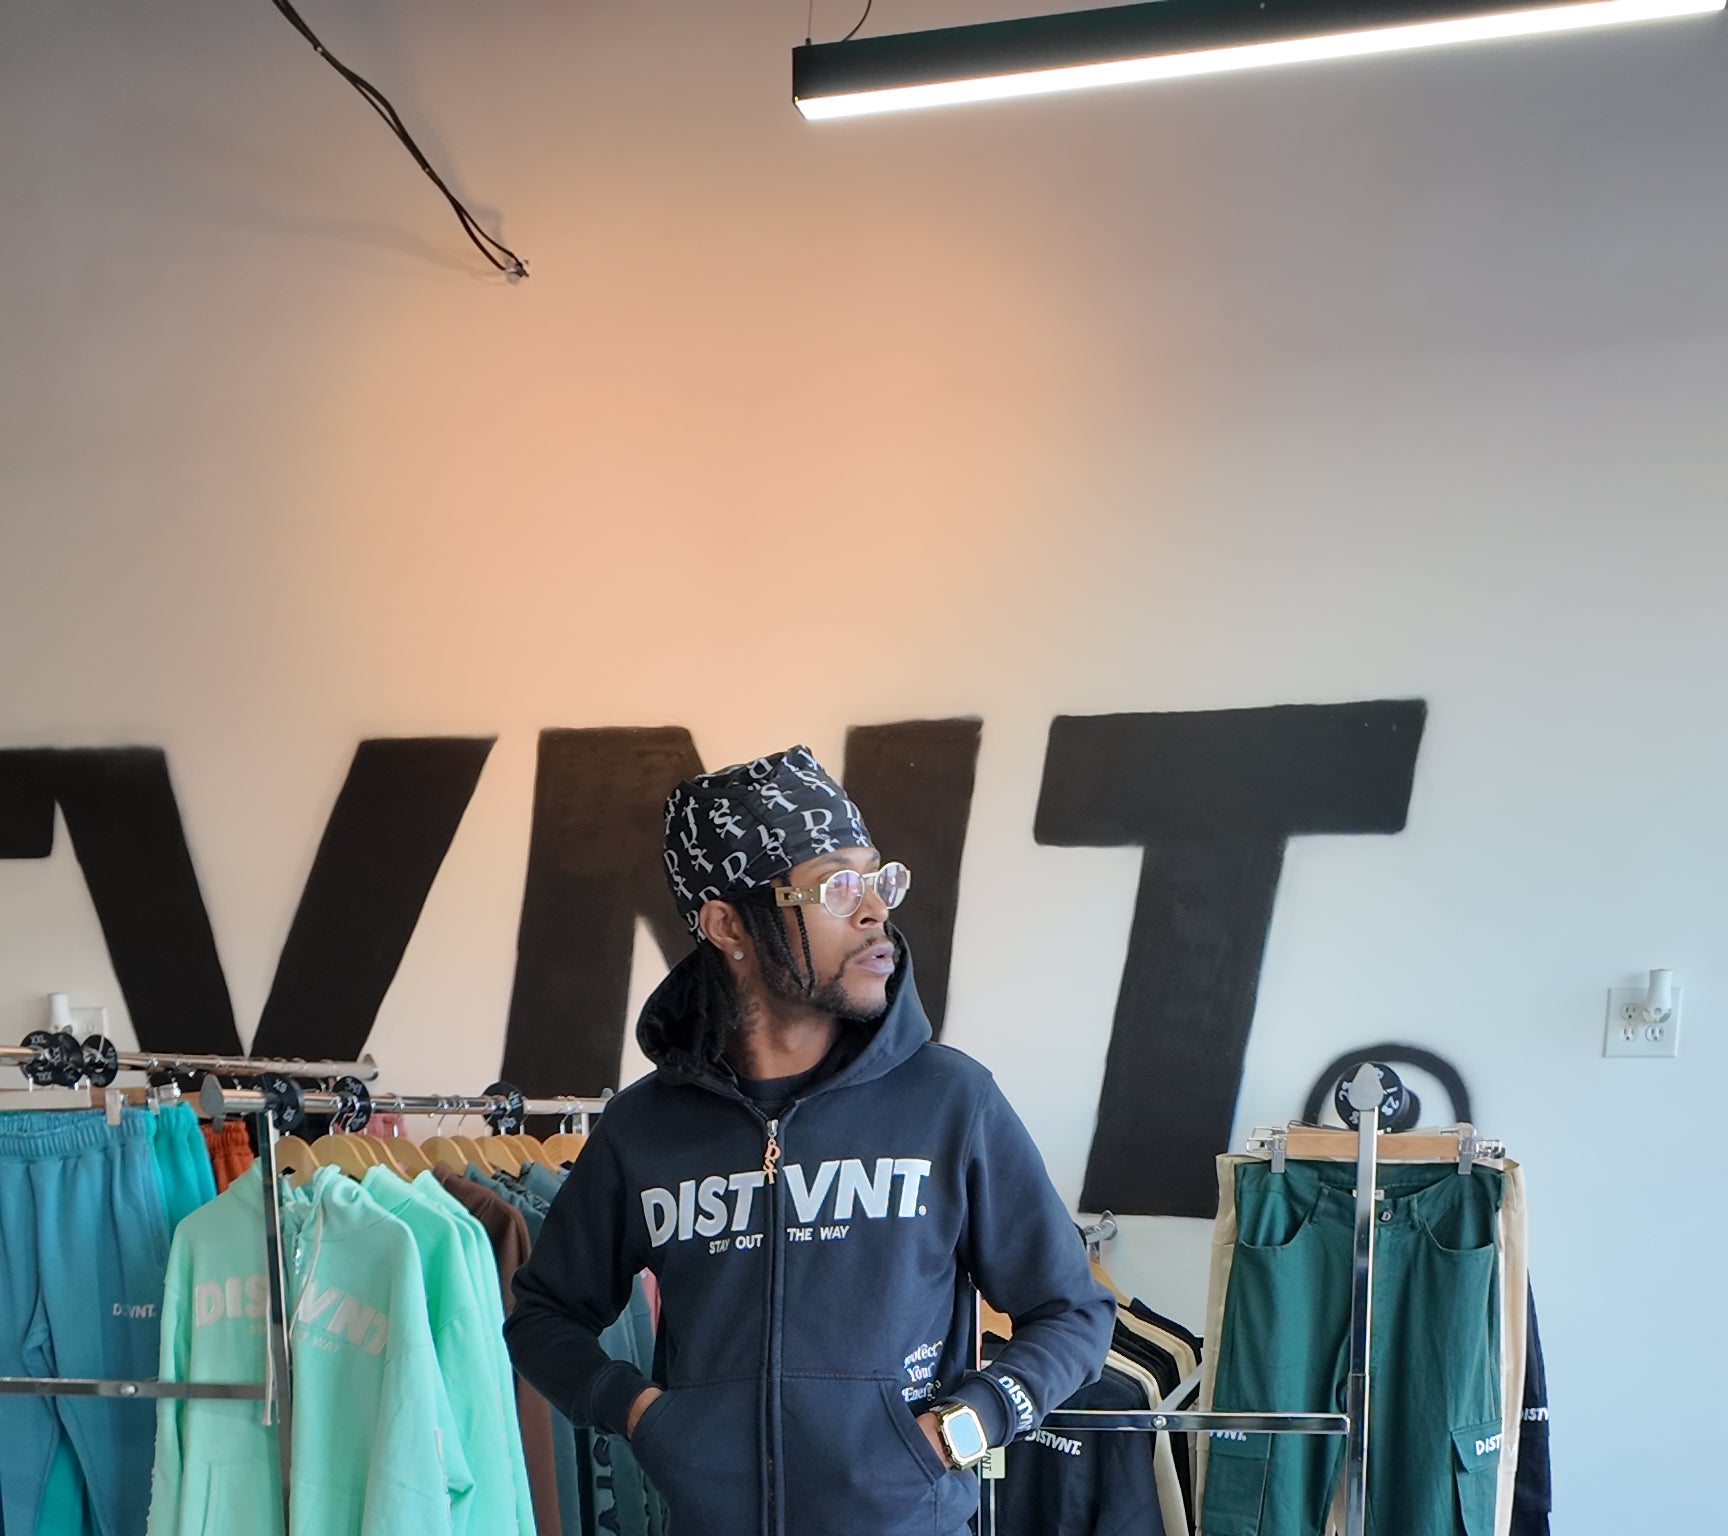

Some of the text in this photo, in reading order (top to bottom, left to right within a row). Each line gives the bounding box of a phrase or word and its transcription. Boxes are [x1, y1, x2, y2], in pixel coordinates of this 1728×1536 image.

[709, 1225, 850, 1255] STAY OUT THE WAY
